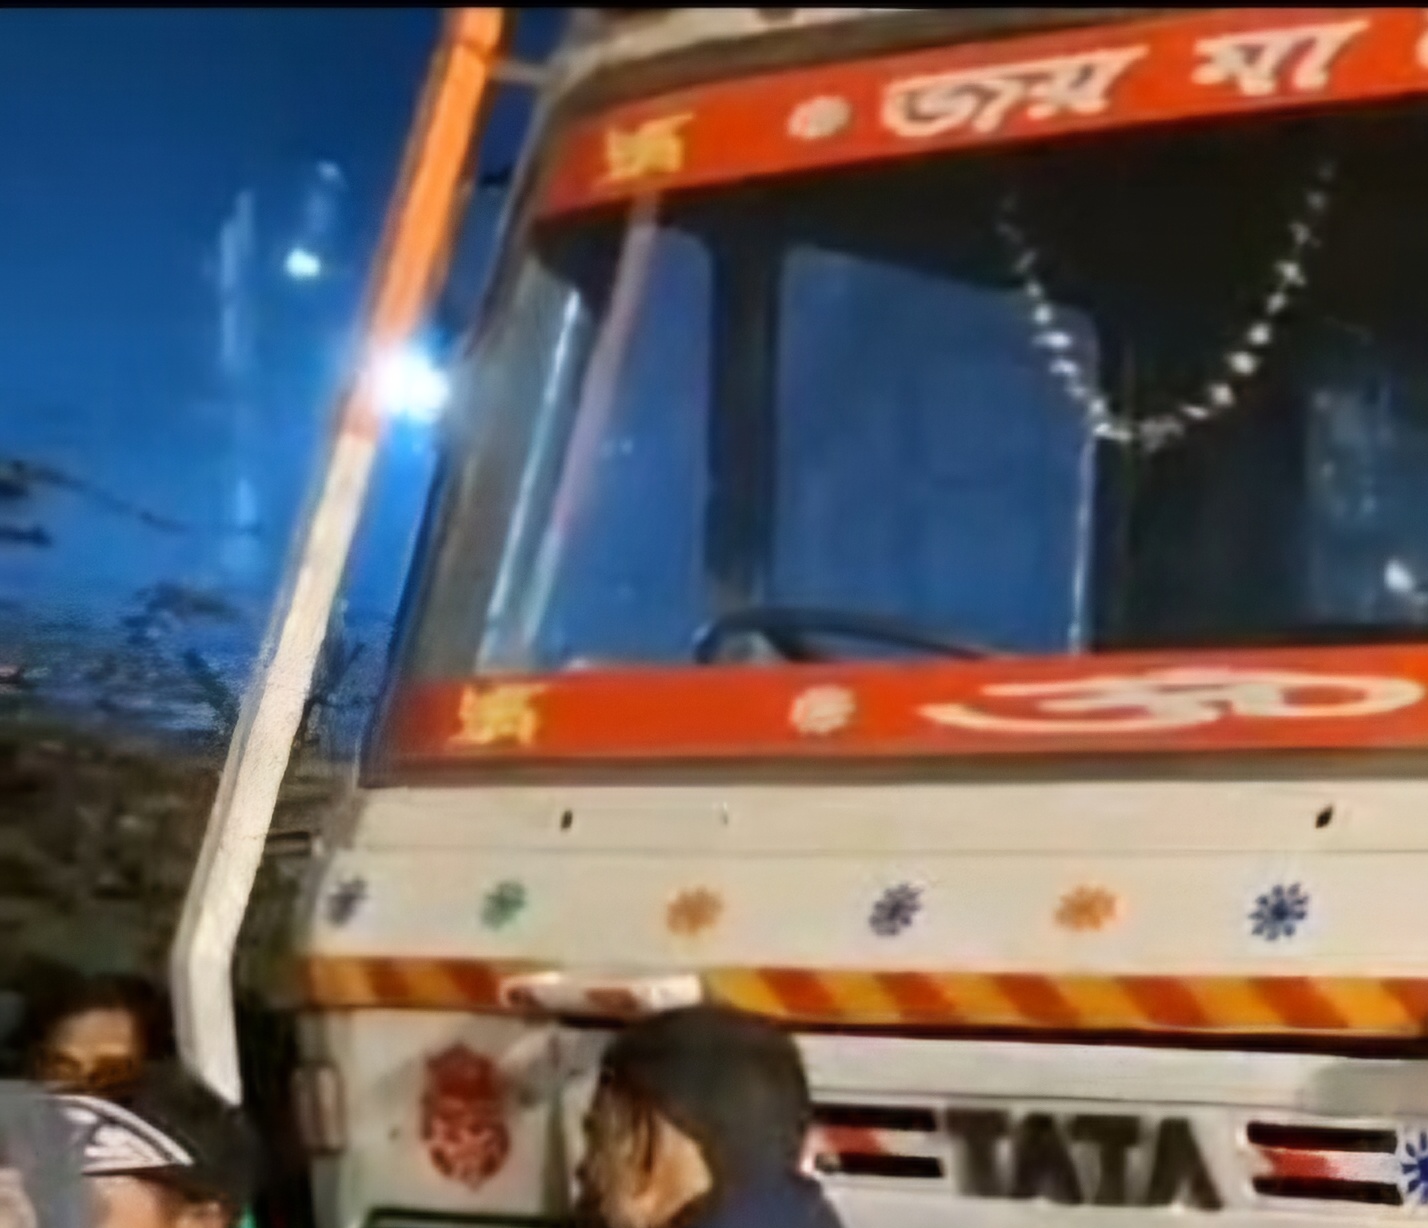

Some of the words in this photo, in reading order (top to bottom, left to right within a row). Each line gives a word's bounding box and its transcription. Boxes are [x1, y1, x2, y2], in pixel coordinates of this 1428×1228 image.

[882, 44, 1150, 137] জয়
[1192, 19, 1371, 95] মা
[945, 1107, 1226, 1211] TATA
